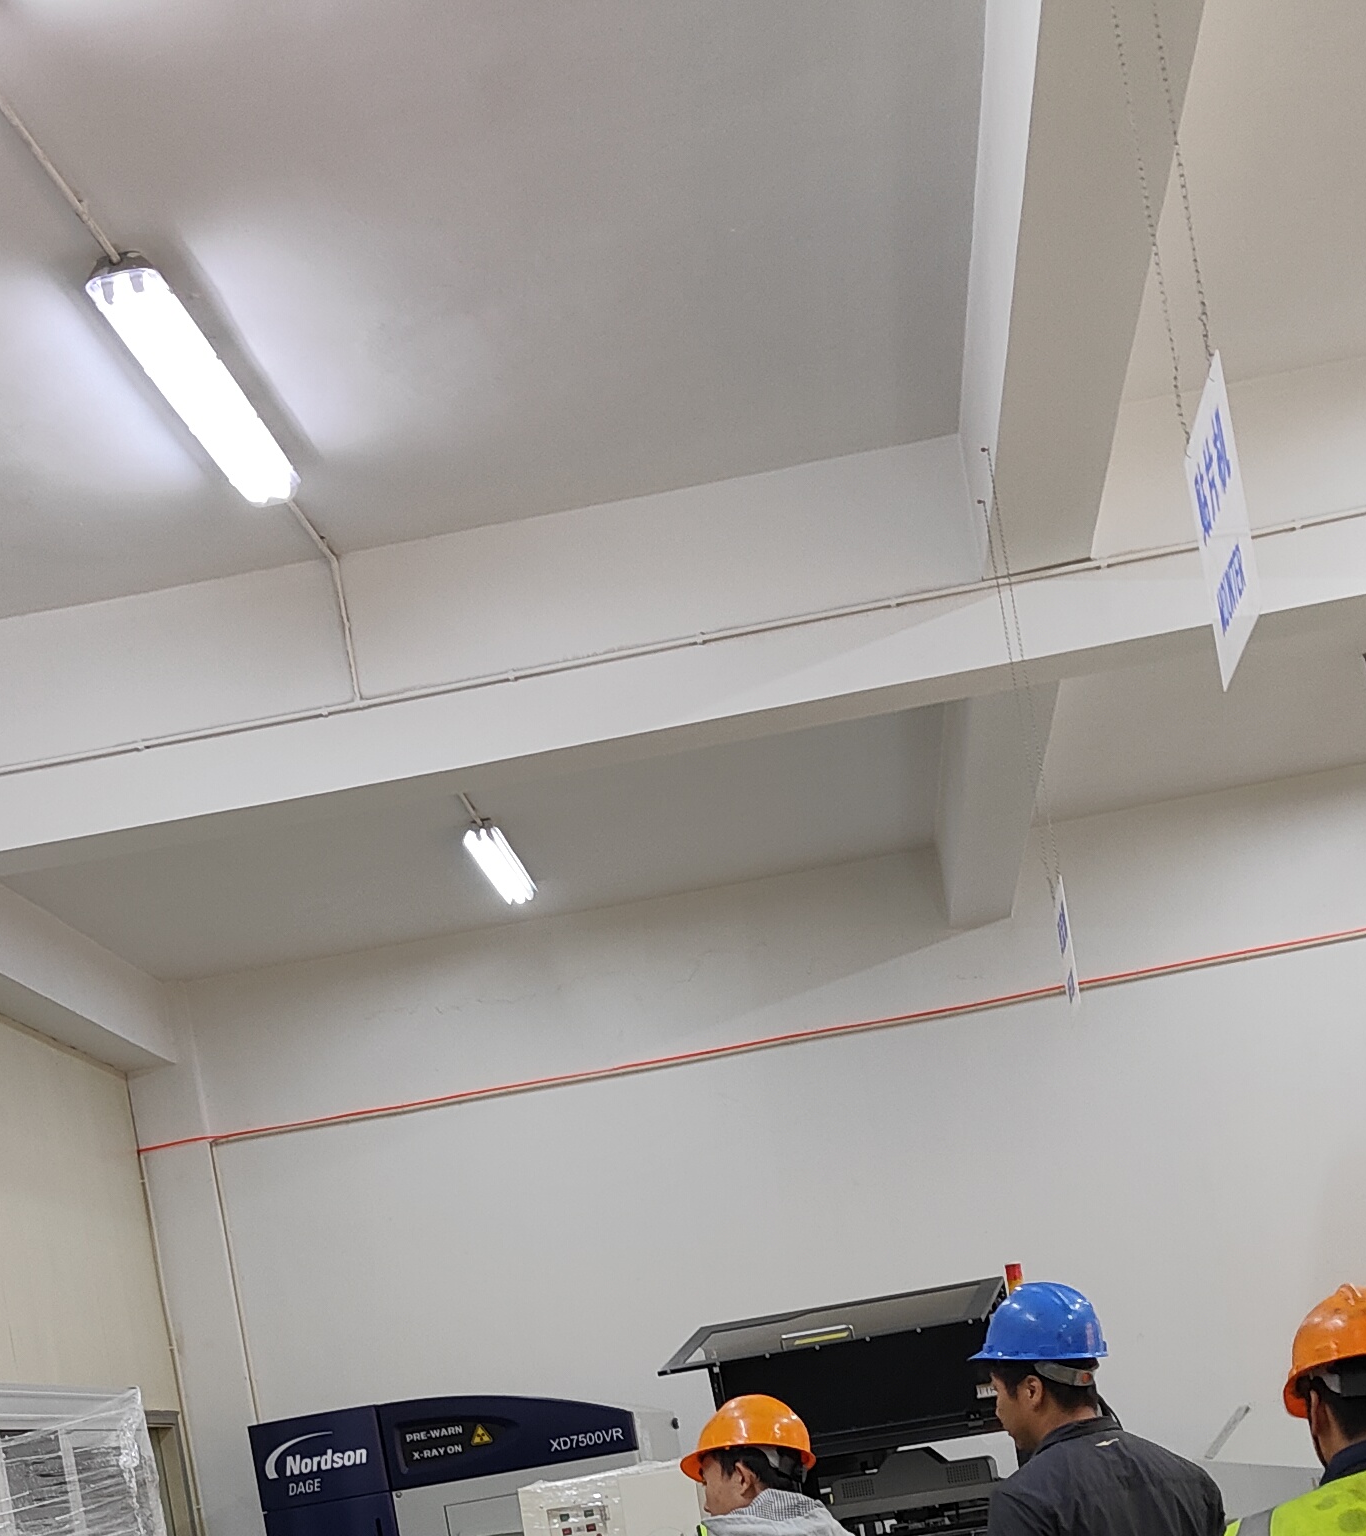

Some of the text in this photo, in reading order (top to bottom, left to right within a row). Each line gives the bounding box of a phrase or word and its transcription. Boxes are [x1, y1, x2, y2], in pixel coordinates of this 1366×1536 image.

[405, 1425, 463, 1443] PRE-WARN
[550, 1427, 624, 1453] XD7500VR
[412, 1443, 464, 1461] X-RAY ON
[285, 1447, 368, 1478] Nordson
[288, 1477, 322, 1497] DAGE
